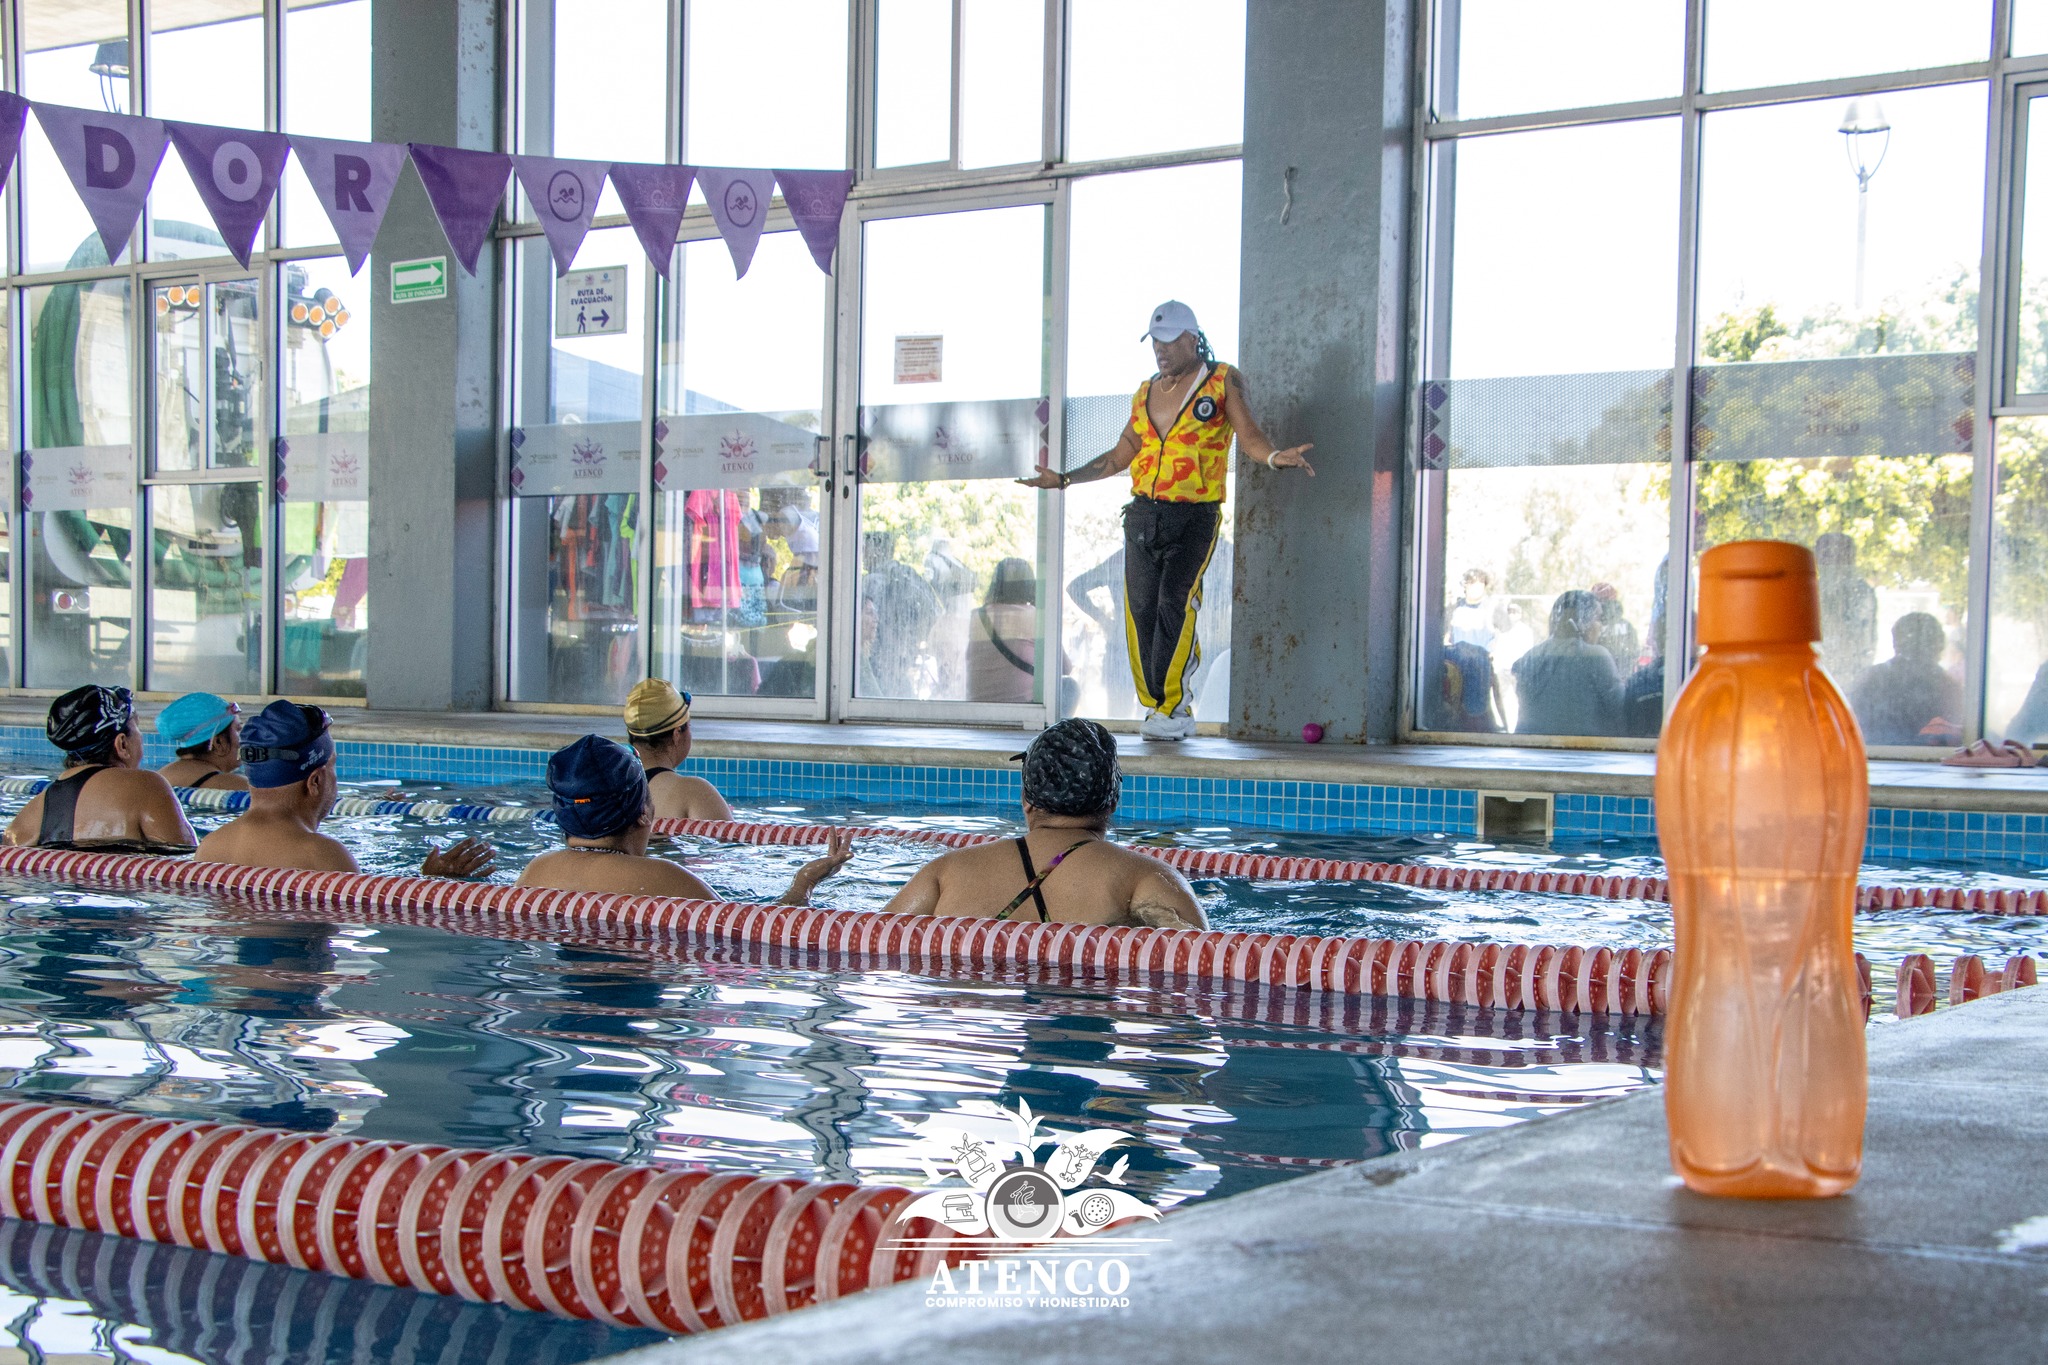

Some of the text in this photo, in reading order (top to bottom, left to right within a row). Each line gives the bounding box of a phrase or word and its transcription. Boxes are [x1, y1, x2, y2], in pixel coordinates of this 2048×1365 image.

[577, 289, 594, 297] RUTA
[571, 293, 613, 305] EVACUACIÓN
[721, 462, 754, 472] ATENCO
[574, 468, 603, 477] ATENCO
[332, 477, 358, 487] ATENCO
